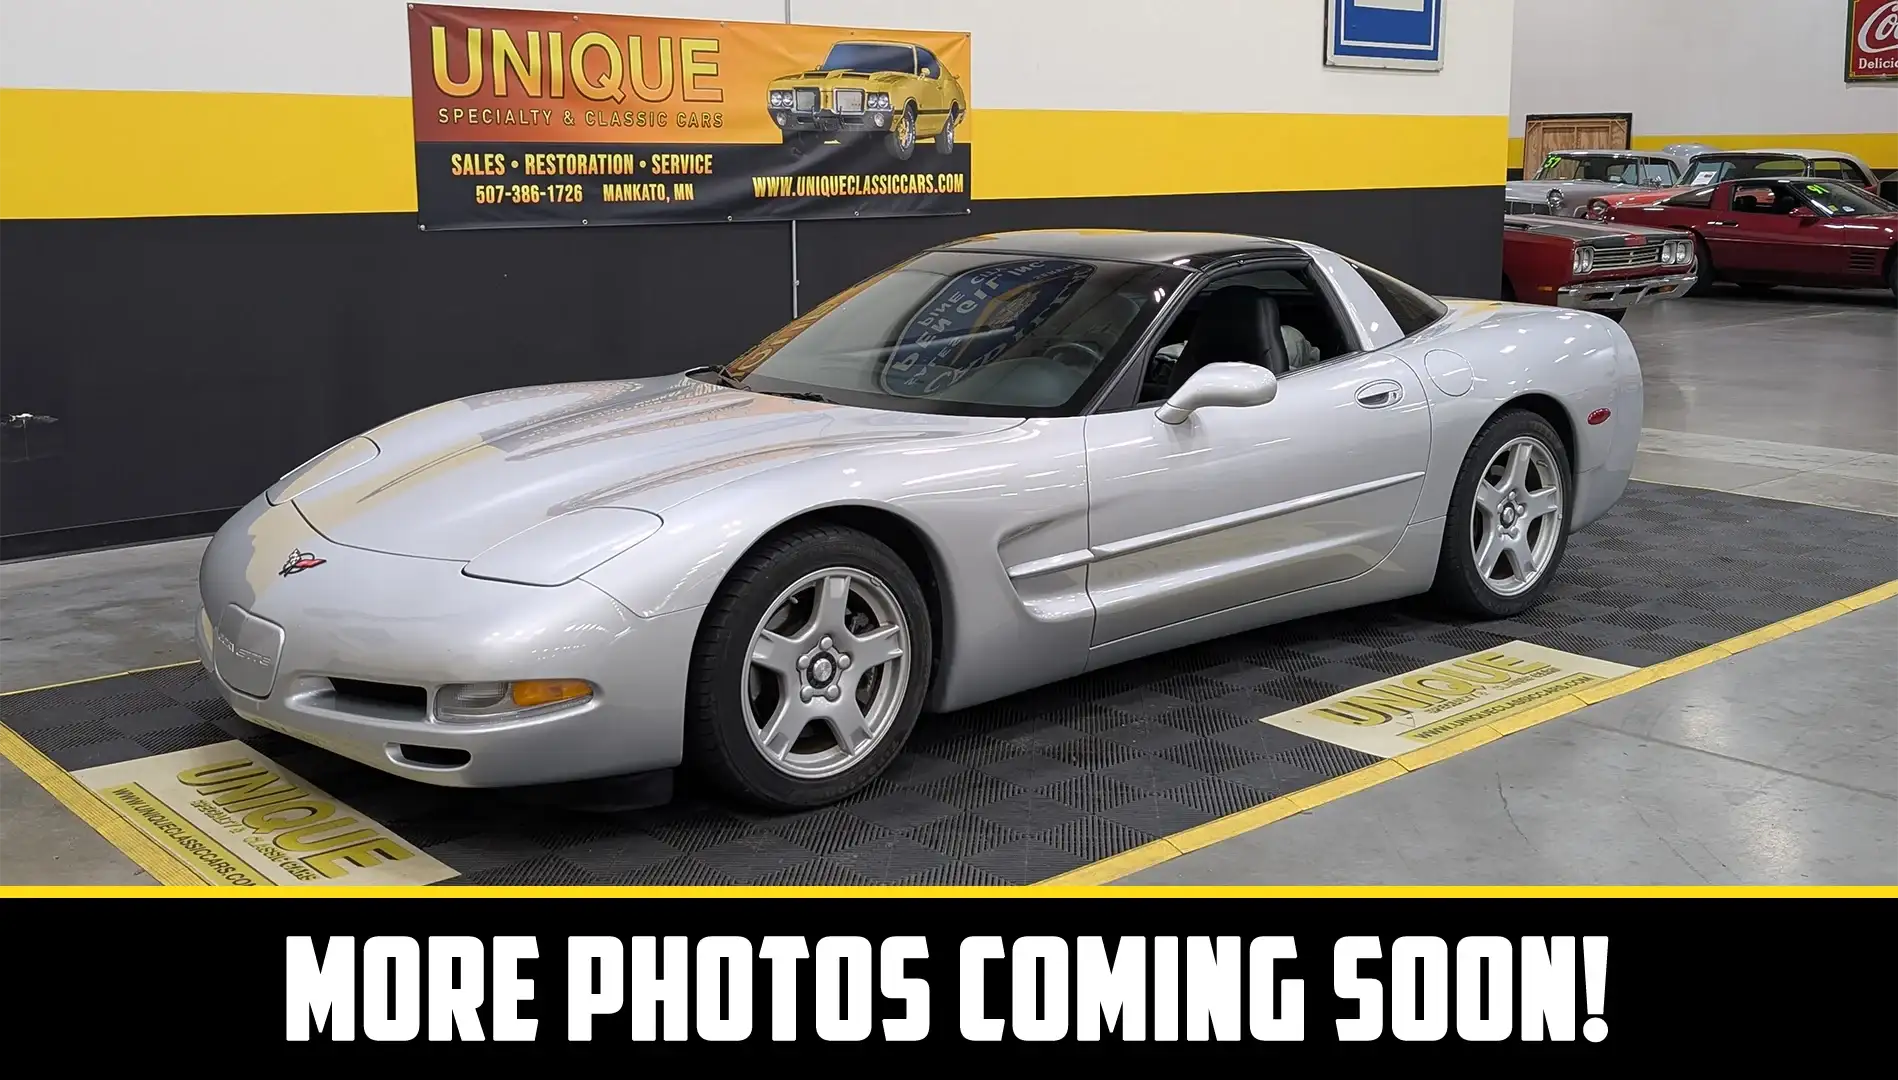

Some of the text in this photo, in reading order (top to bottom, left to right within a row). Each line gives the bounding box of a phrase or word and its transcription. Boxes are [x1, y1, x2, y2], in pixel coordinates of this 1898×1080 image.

[431, 26, 724, 104] UNIQUE
[439, 108, 724, 128] SPECIALTY & CLASSIC CARS
[451, 153, 713, 176] SALES RESTORATION SERVICE
[475, 183, 695, 204] 507-386-1726 MANKATO, MN
[752, 173, 964, 198] WWW.UNIQUECLASSICCARS.COM
[1806, 184, 1830, 194] 91
[1310, 651, 1551, 727] UNIQUE
[177, 758, 415, 879] UNIQUE
